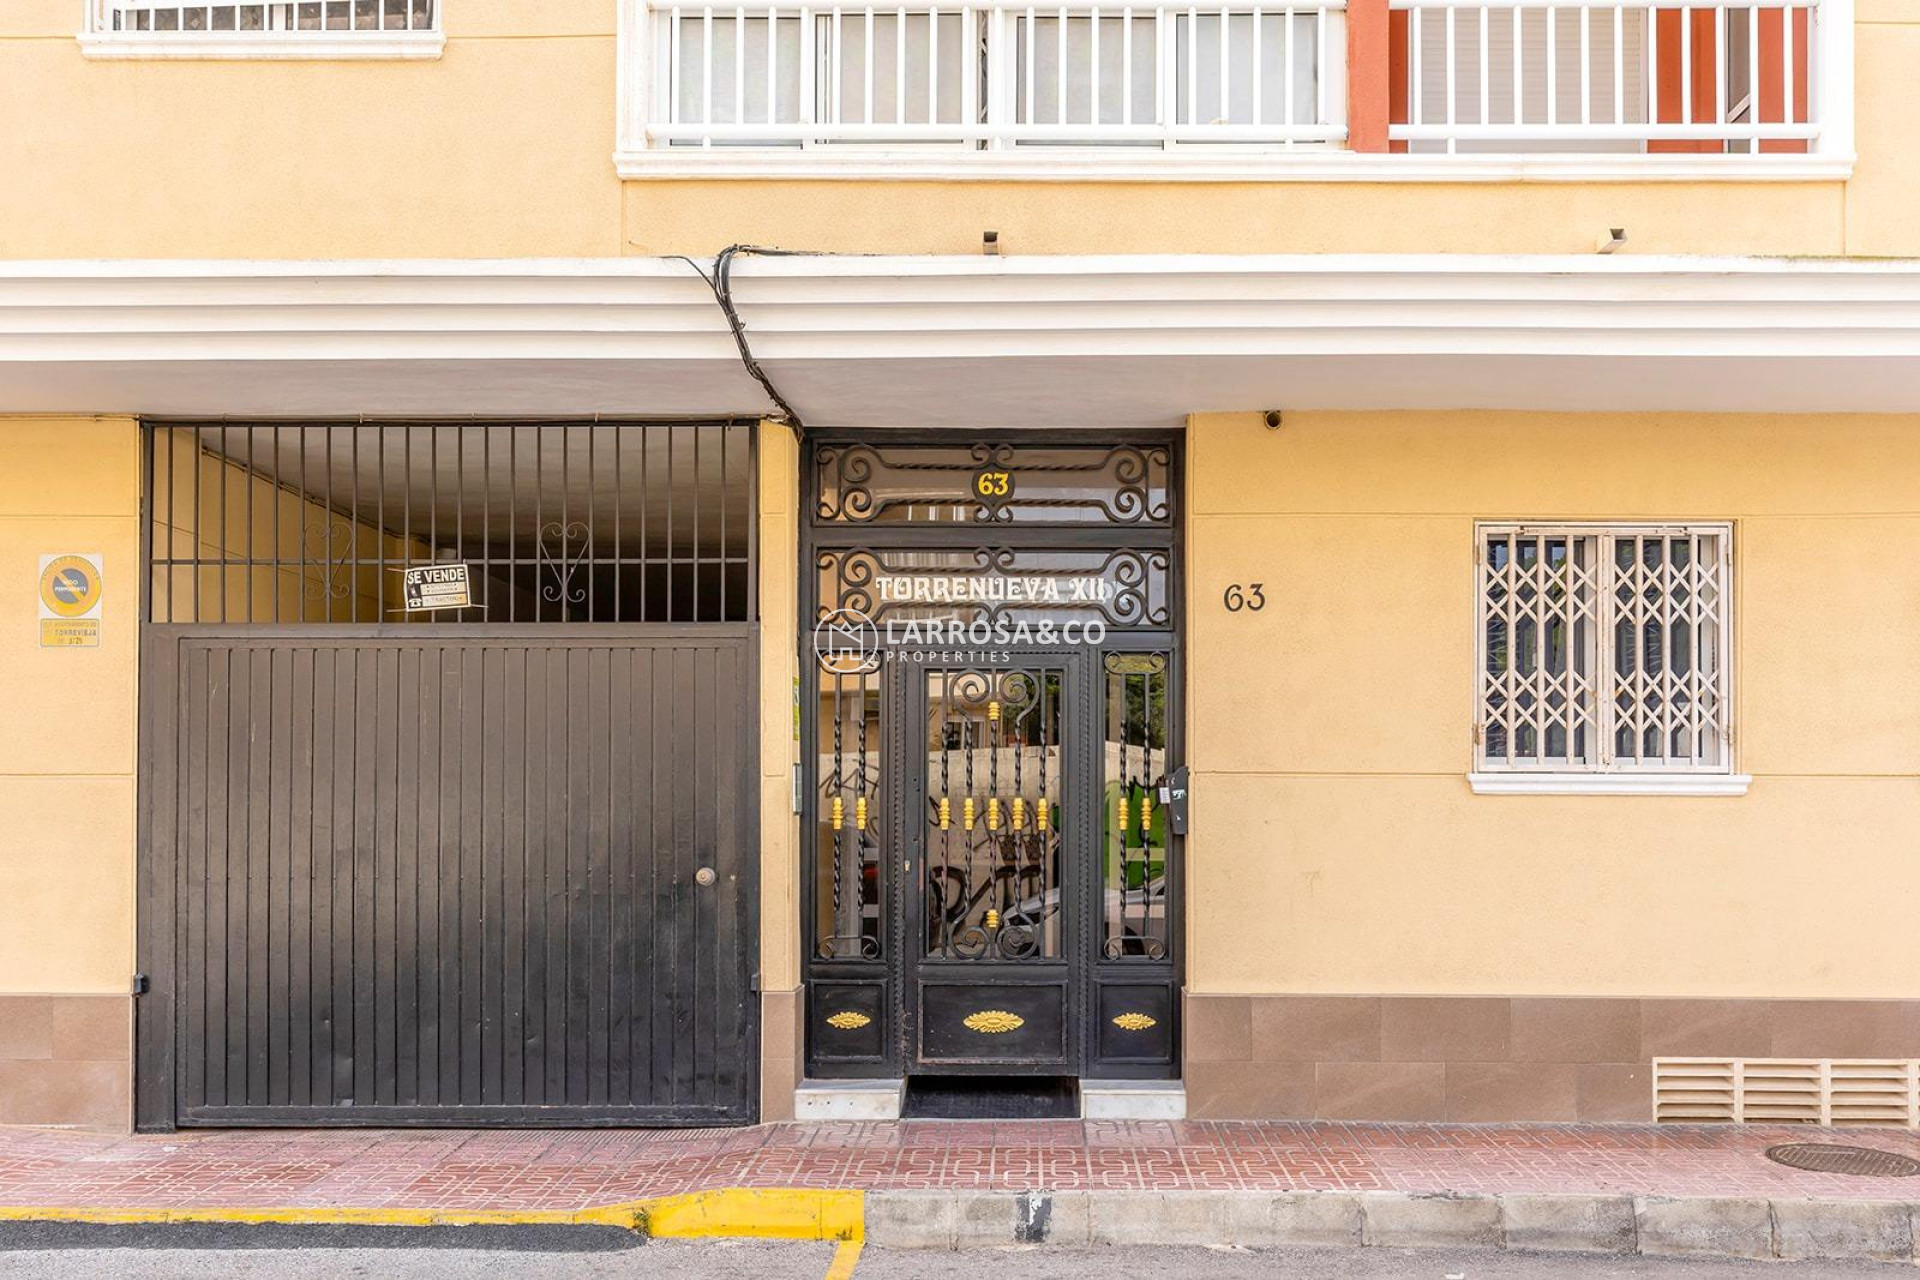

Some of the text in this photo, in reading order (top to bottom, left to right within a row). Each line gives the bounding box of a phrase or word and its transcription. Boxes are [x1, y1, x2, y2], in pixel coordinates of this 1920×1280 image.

[978, 472, 1009, 496] 63
[407, 568, 465, 585] SE VENDE
[875, 576, 1060, 602] TORRENUEVA
[1223, 583, 1266, 612] 63
